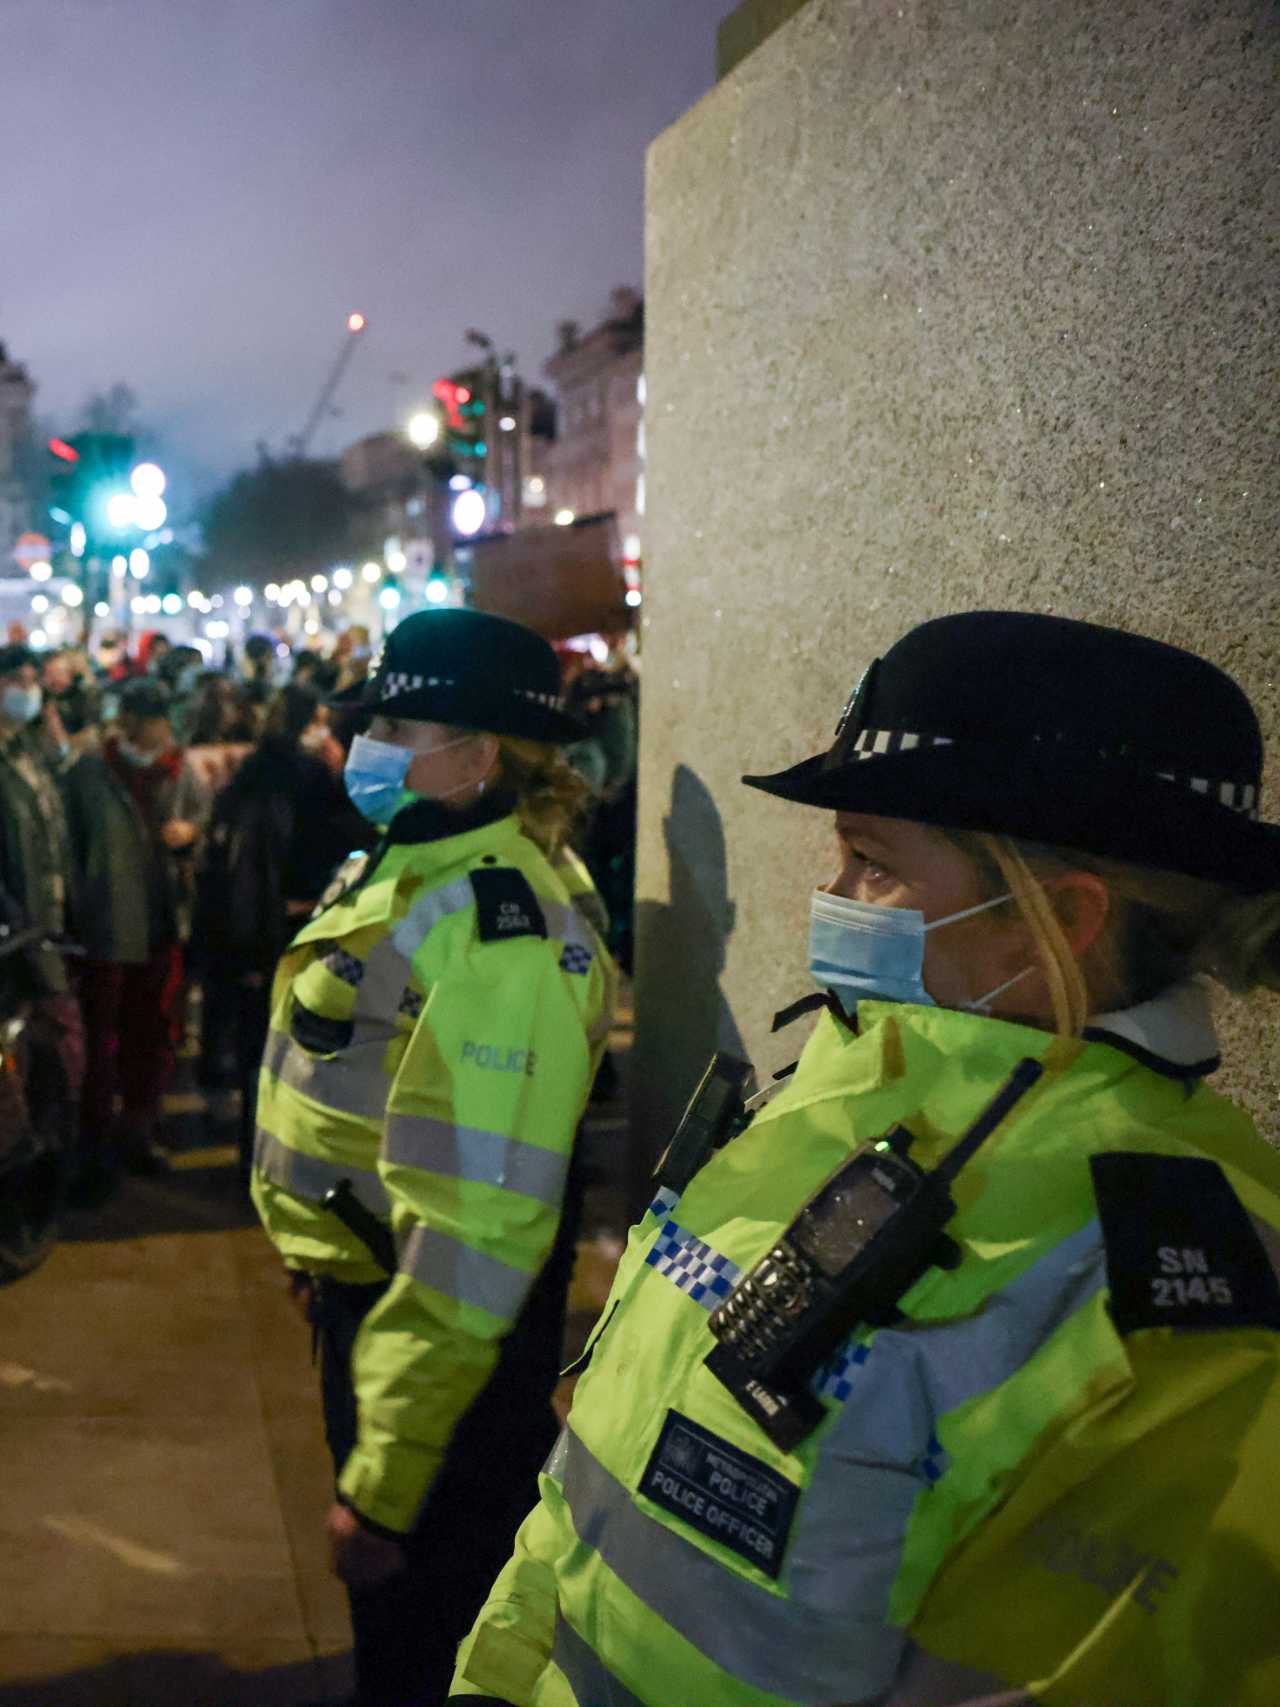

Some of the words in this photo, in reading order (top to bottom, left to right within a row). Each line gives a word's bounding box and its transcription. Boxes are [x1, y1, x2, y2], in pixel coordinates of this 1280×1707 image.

[459, 1037, 537, 1078] POLICE
[1156, 1246, 1208, 1274] SN
[1150, 1276, 1233, 1307] 2145
[708, 1471, 769, 1516] POLICE
[651, 1470, 705, 1517] POLICE
[705, 1505, 775, 1559] OFFICER
